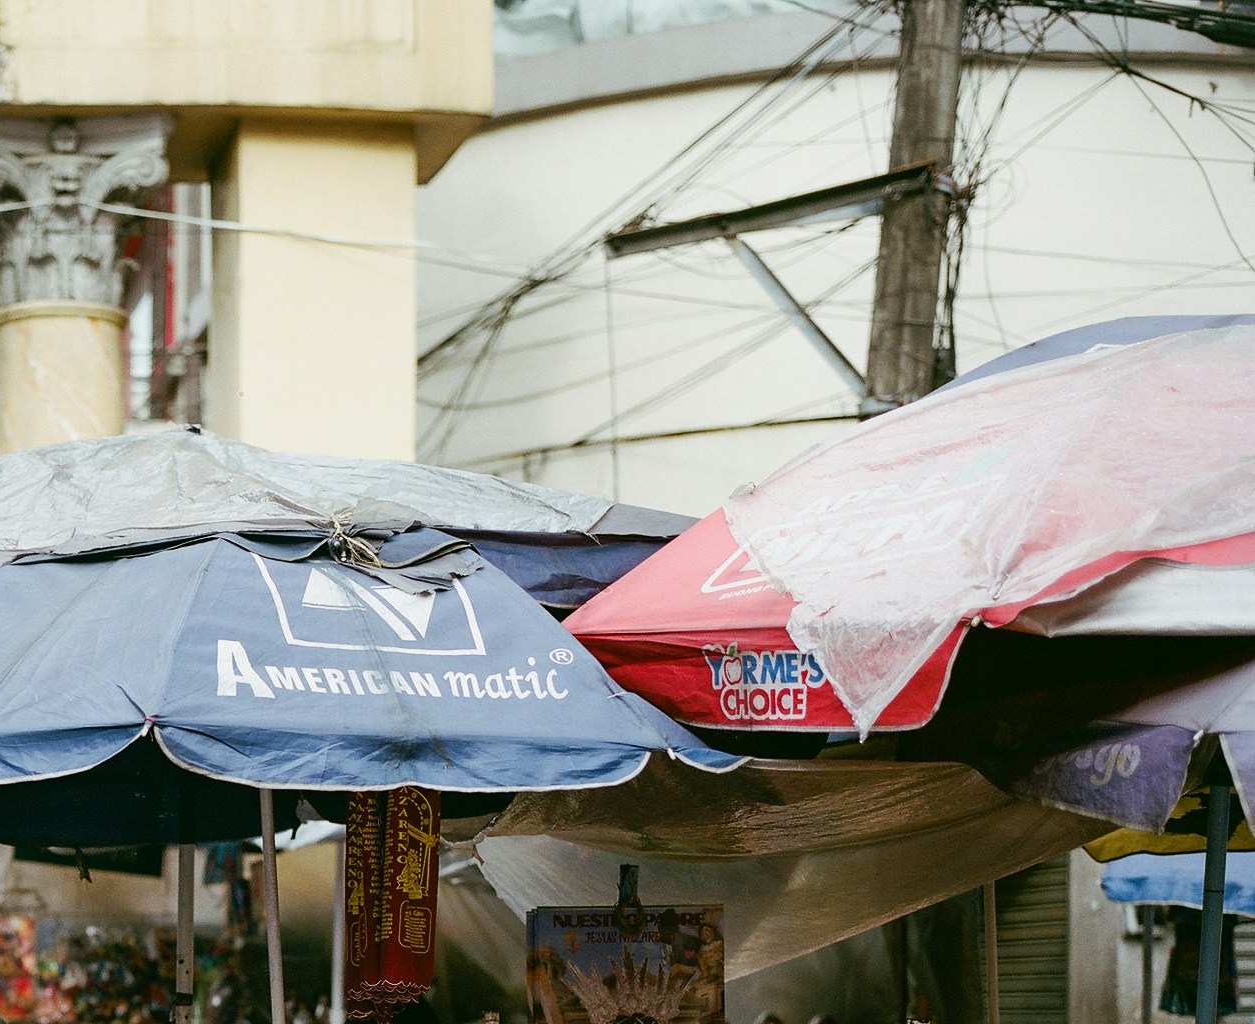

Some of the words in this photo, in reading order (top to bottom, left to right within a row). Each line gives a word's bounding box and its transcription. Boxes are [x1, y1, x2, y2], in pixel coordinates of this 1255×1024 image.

[216, 639, 442, 699] AMERICAN
[443, 657, 569, 700] matic
[723, 687, 805, 718] CHOICE
[348, 801, 358, 888] NAZARENO
[584, 932, 617, 943] JESUS
